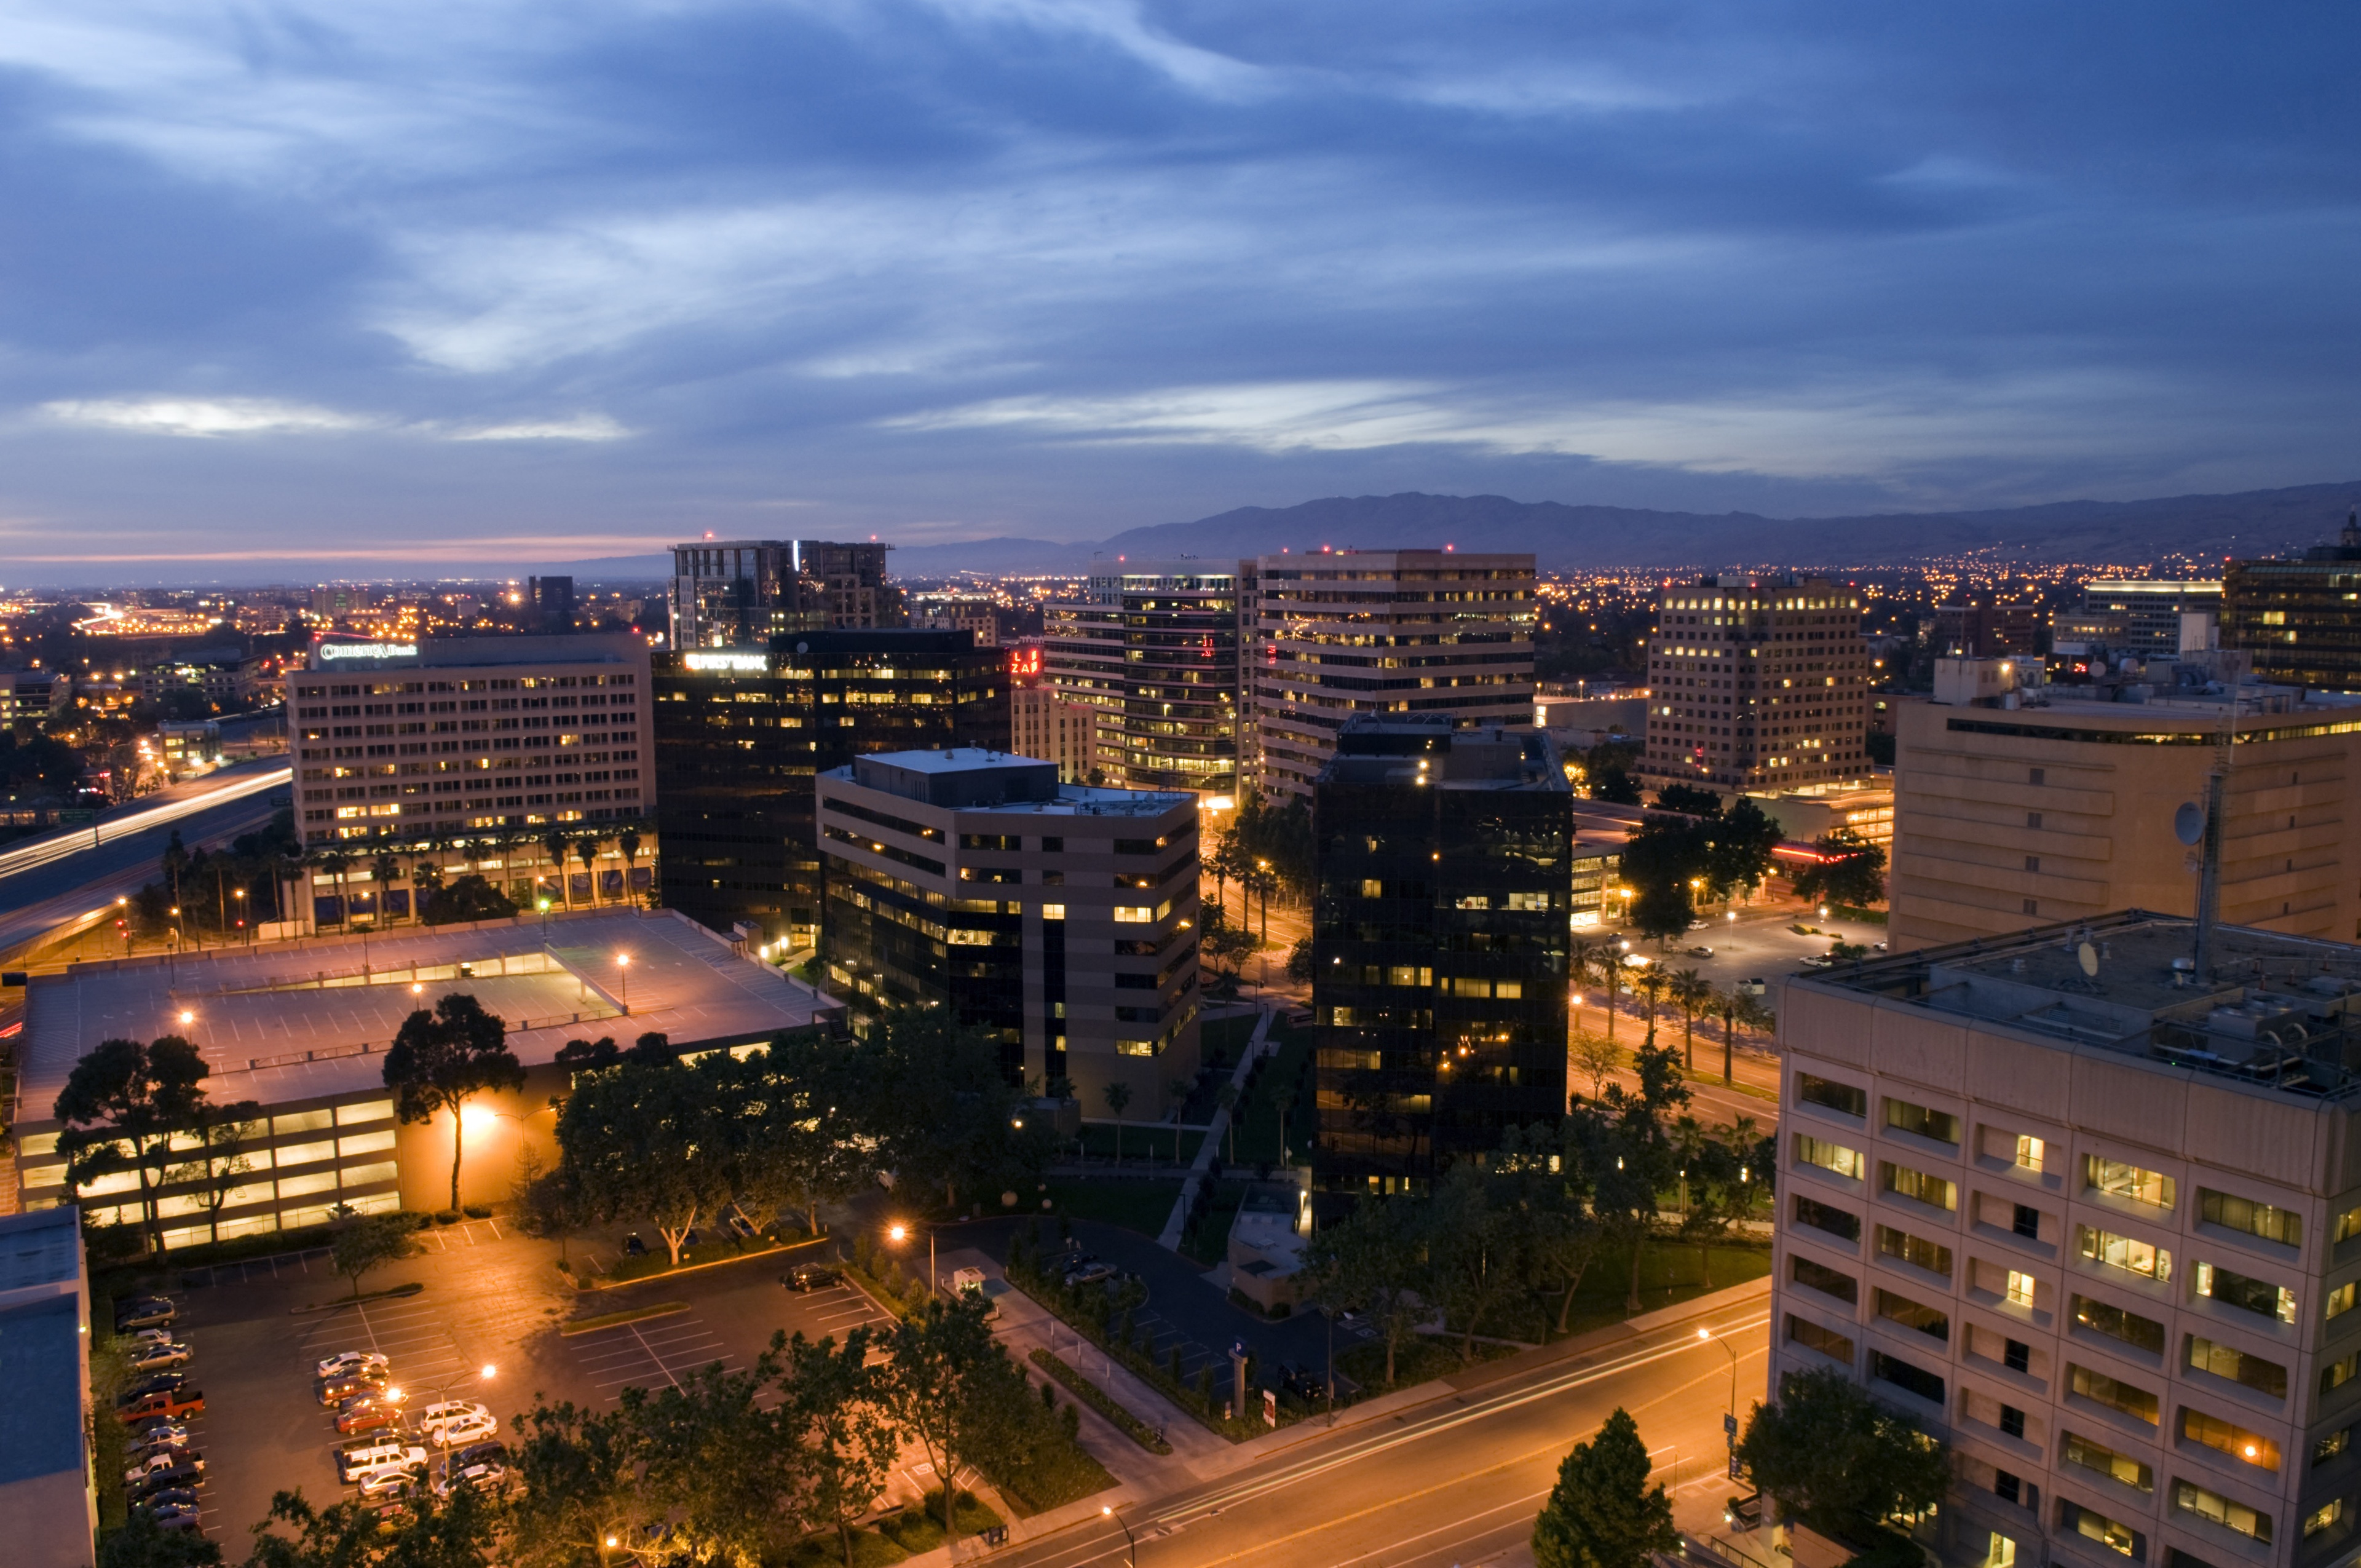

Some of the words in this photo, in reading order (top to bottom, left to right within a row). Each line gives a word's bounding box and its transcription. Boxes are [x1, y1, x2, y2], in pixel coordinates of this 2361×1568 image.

[387, 644, 417, 655] Bank
[700, 655, 734, 669] FIRST
[734, 655, 767, 671] BANK
[1236, 1342, 1241, 1352] P
